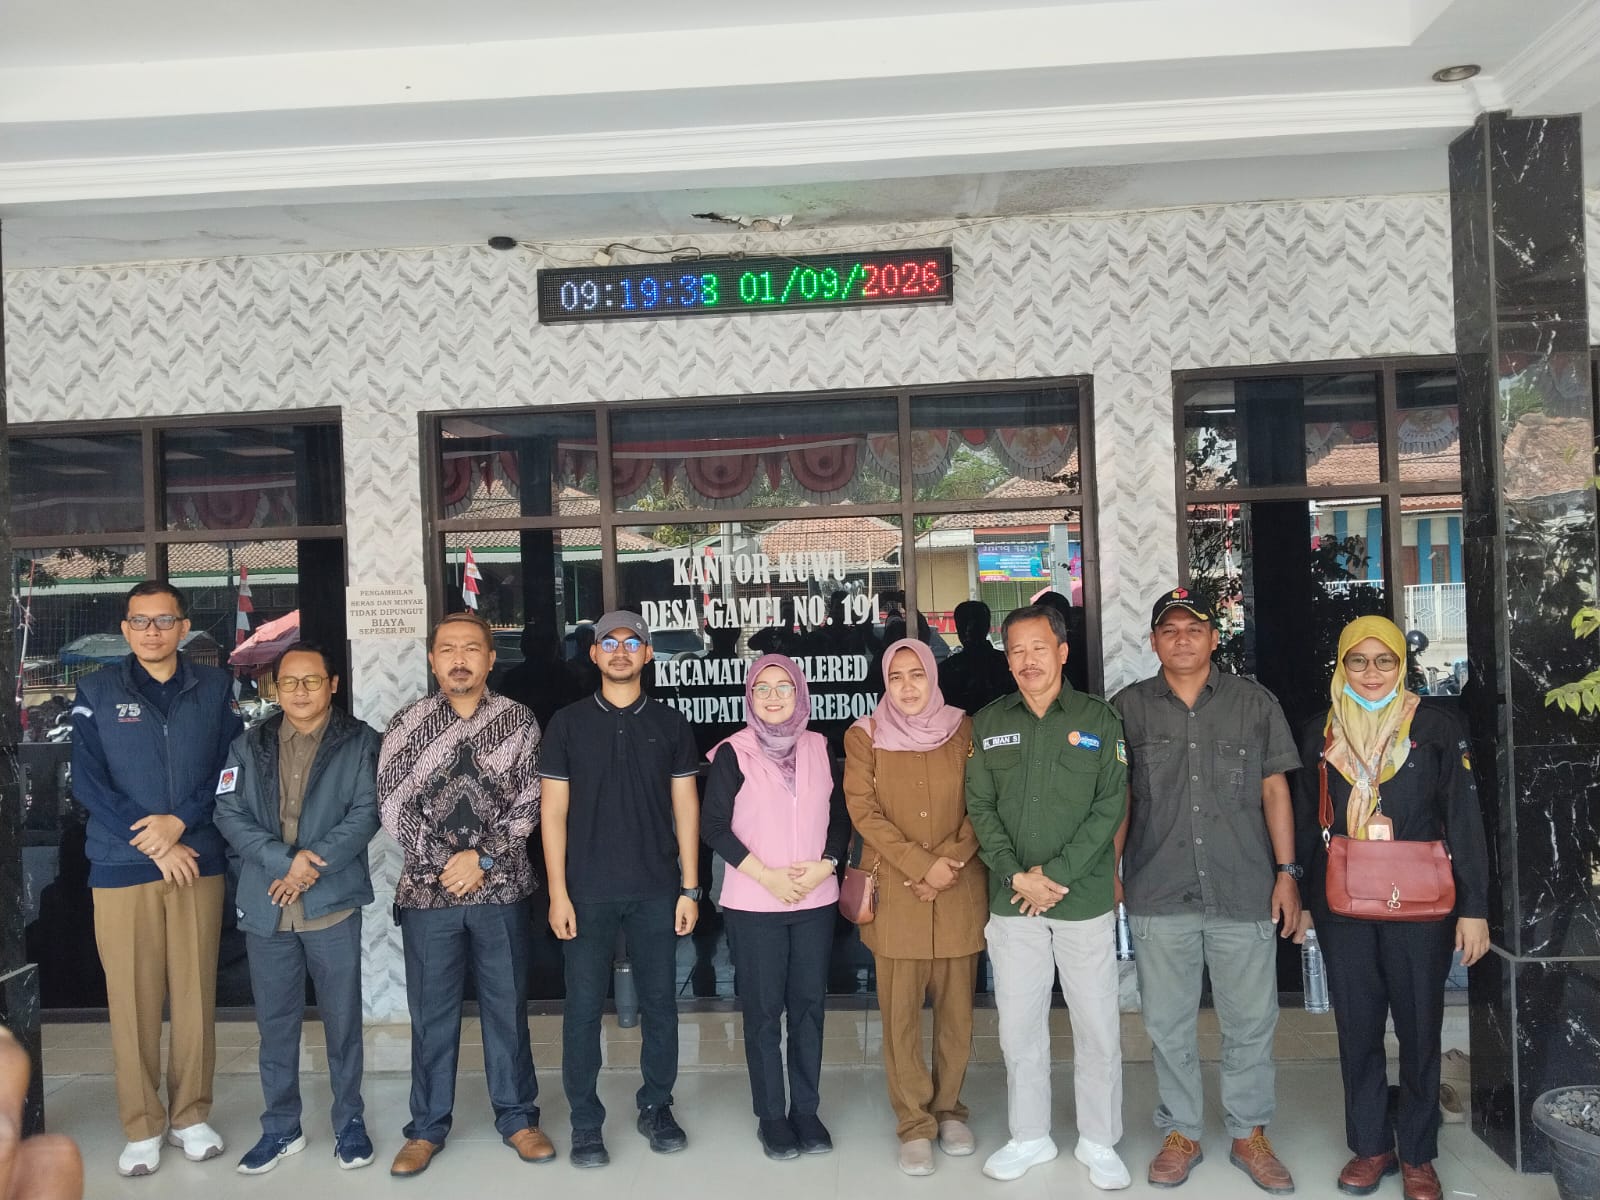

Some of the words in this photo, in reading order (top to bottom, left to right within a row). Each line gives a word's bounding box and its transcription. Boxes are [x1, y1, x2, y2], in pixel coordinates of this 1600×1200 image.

[739, 261, 940, 303] 01/09/2026
[673, 553, 770, 586] KANTOR
[779, 551, 846, 583] KUWU
[350, 609, 377, 617] TIDAK
[380, 608, 424, 616] DIPUNGUT
[371, 618, 405, 627] BIAYA
[641, 599, 699, 631] DESA
[707, 596, 786, 629] GAMEL
[793, 595, 833, 626] NO.
[842, 594, 880, 625] 191
[360, 627, 397, 635] SEPESER
[400, 626, 416, 634] PUN
[654, 658, 752, 687] KECAMATA
[116, 703, 141, 717] 75
[809, 693, 879, 721] REBON
